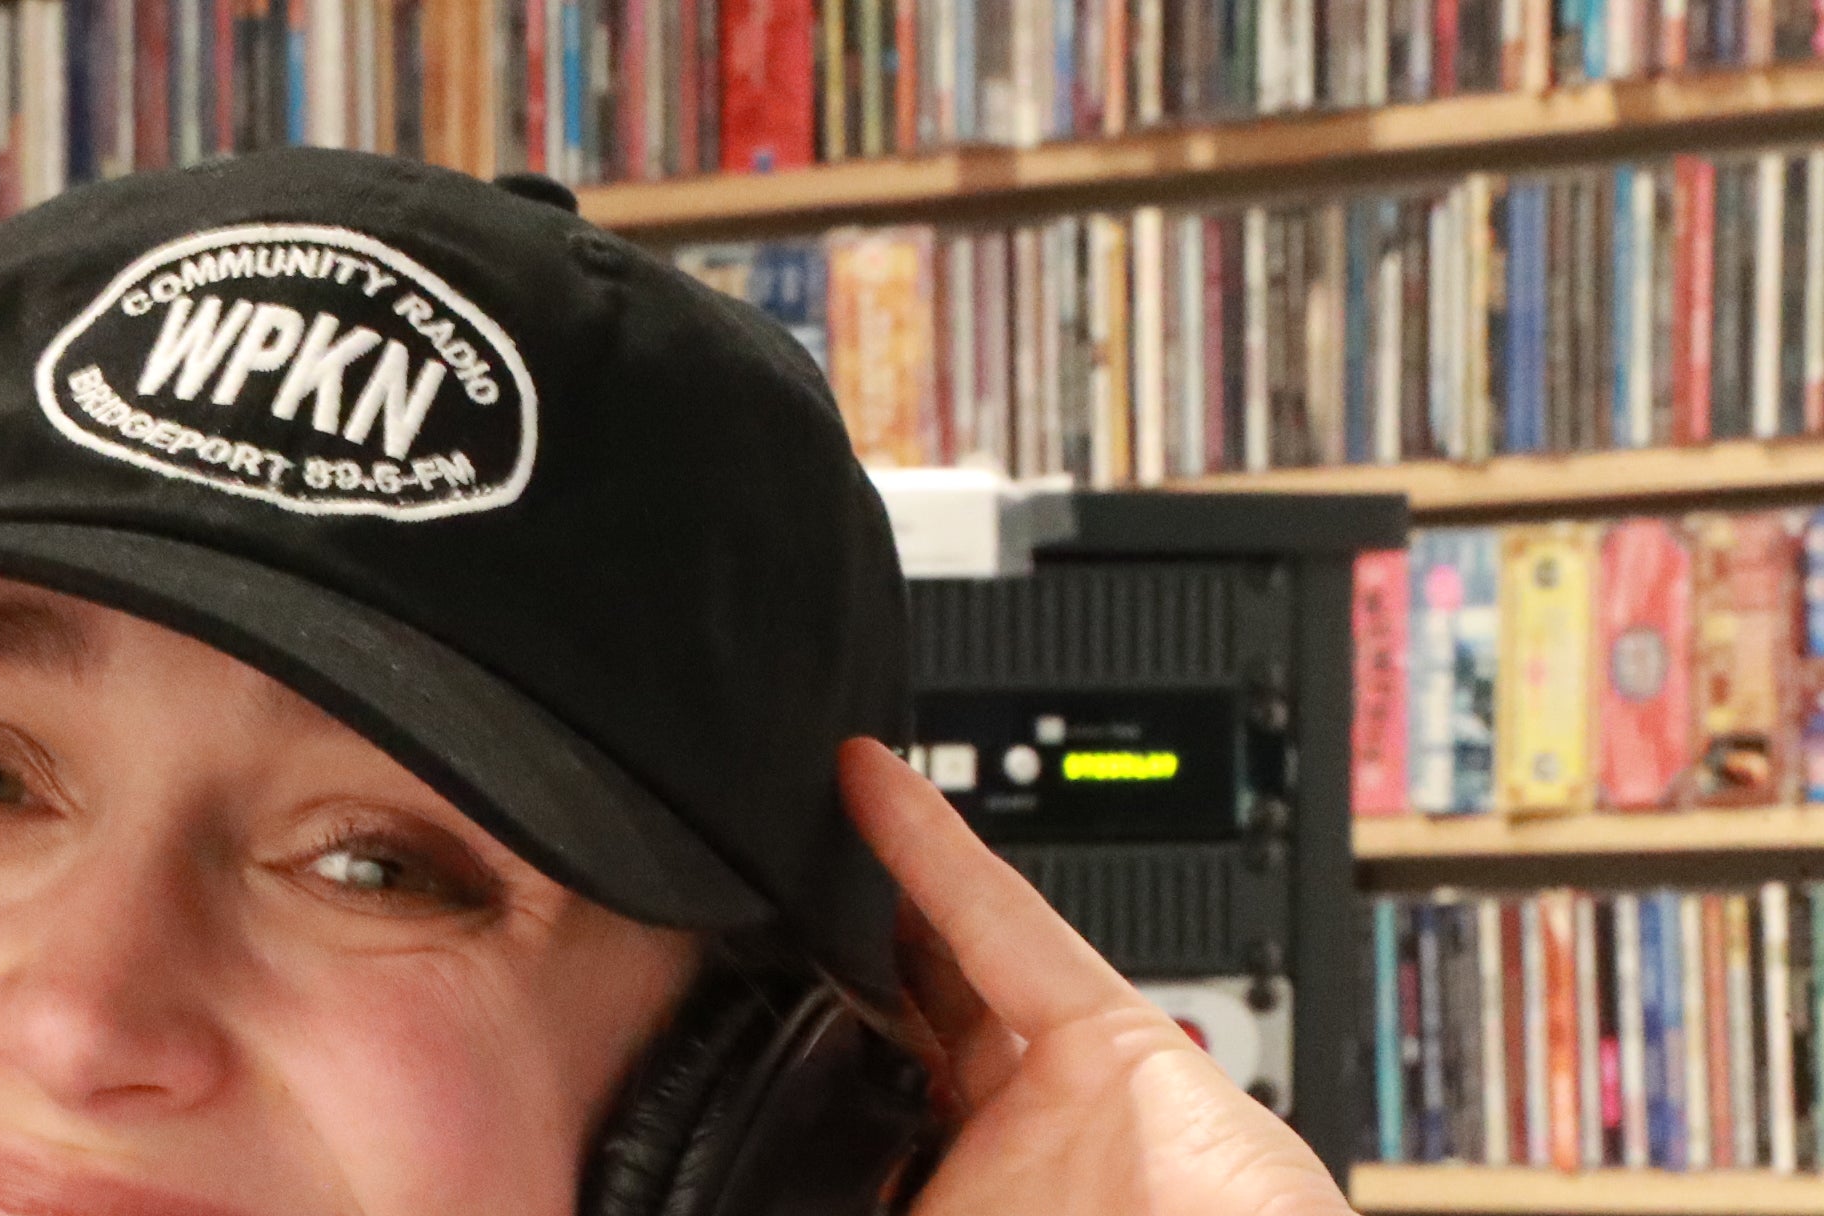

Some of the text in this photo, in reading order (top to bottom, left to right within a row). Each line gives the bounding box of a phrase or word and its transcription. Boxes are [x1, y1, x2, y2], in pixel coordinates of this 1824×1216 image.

[122, 244, 500, 406] COMMUNITY RADIO
[136, 295, 448, 460] WPKN
[67, 363, 296, 484] BRIDGEPORT
